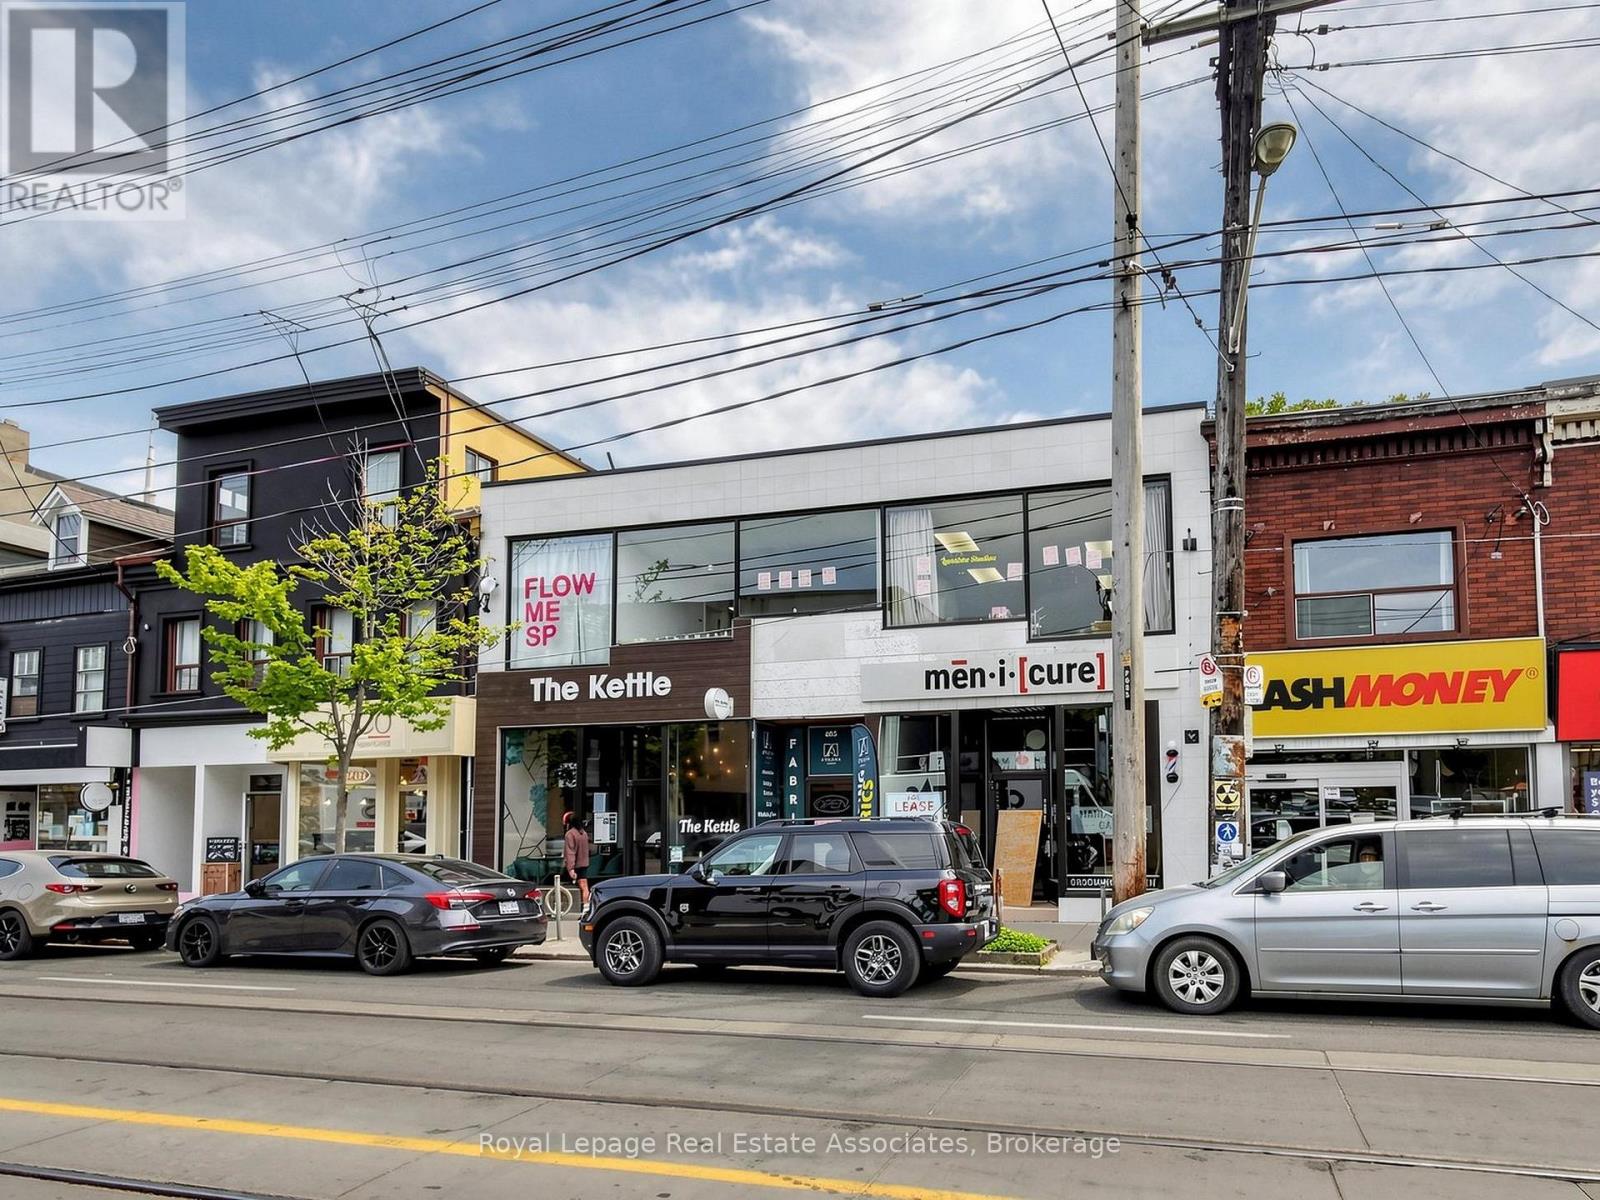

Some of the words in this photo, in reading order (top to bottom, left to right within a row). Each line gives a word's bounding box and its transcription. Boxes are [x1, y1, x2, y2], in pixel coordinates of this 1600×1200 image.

[524, 572, 596, 600] FLOW
[525, 600, 560, 623] ME
[526, 624, 557, 647] SP
[530, 677, 580, 702] The
[589, 671, 672, 700] Kettle
[895, 800, 935, 812] LEASE
[679, 818, 702, 833] The
[703, 818, 741, 833] Kettle
